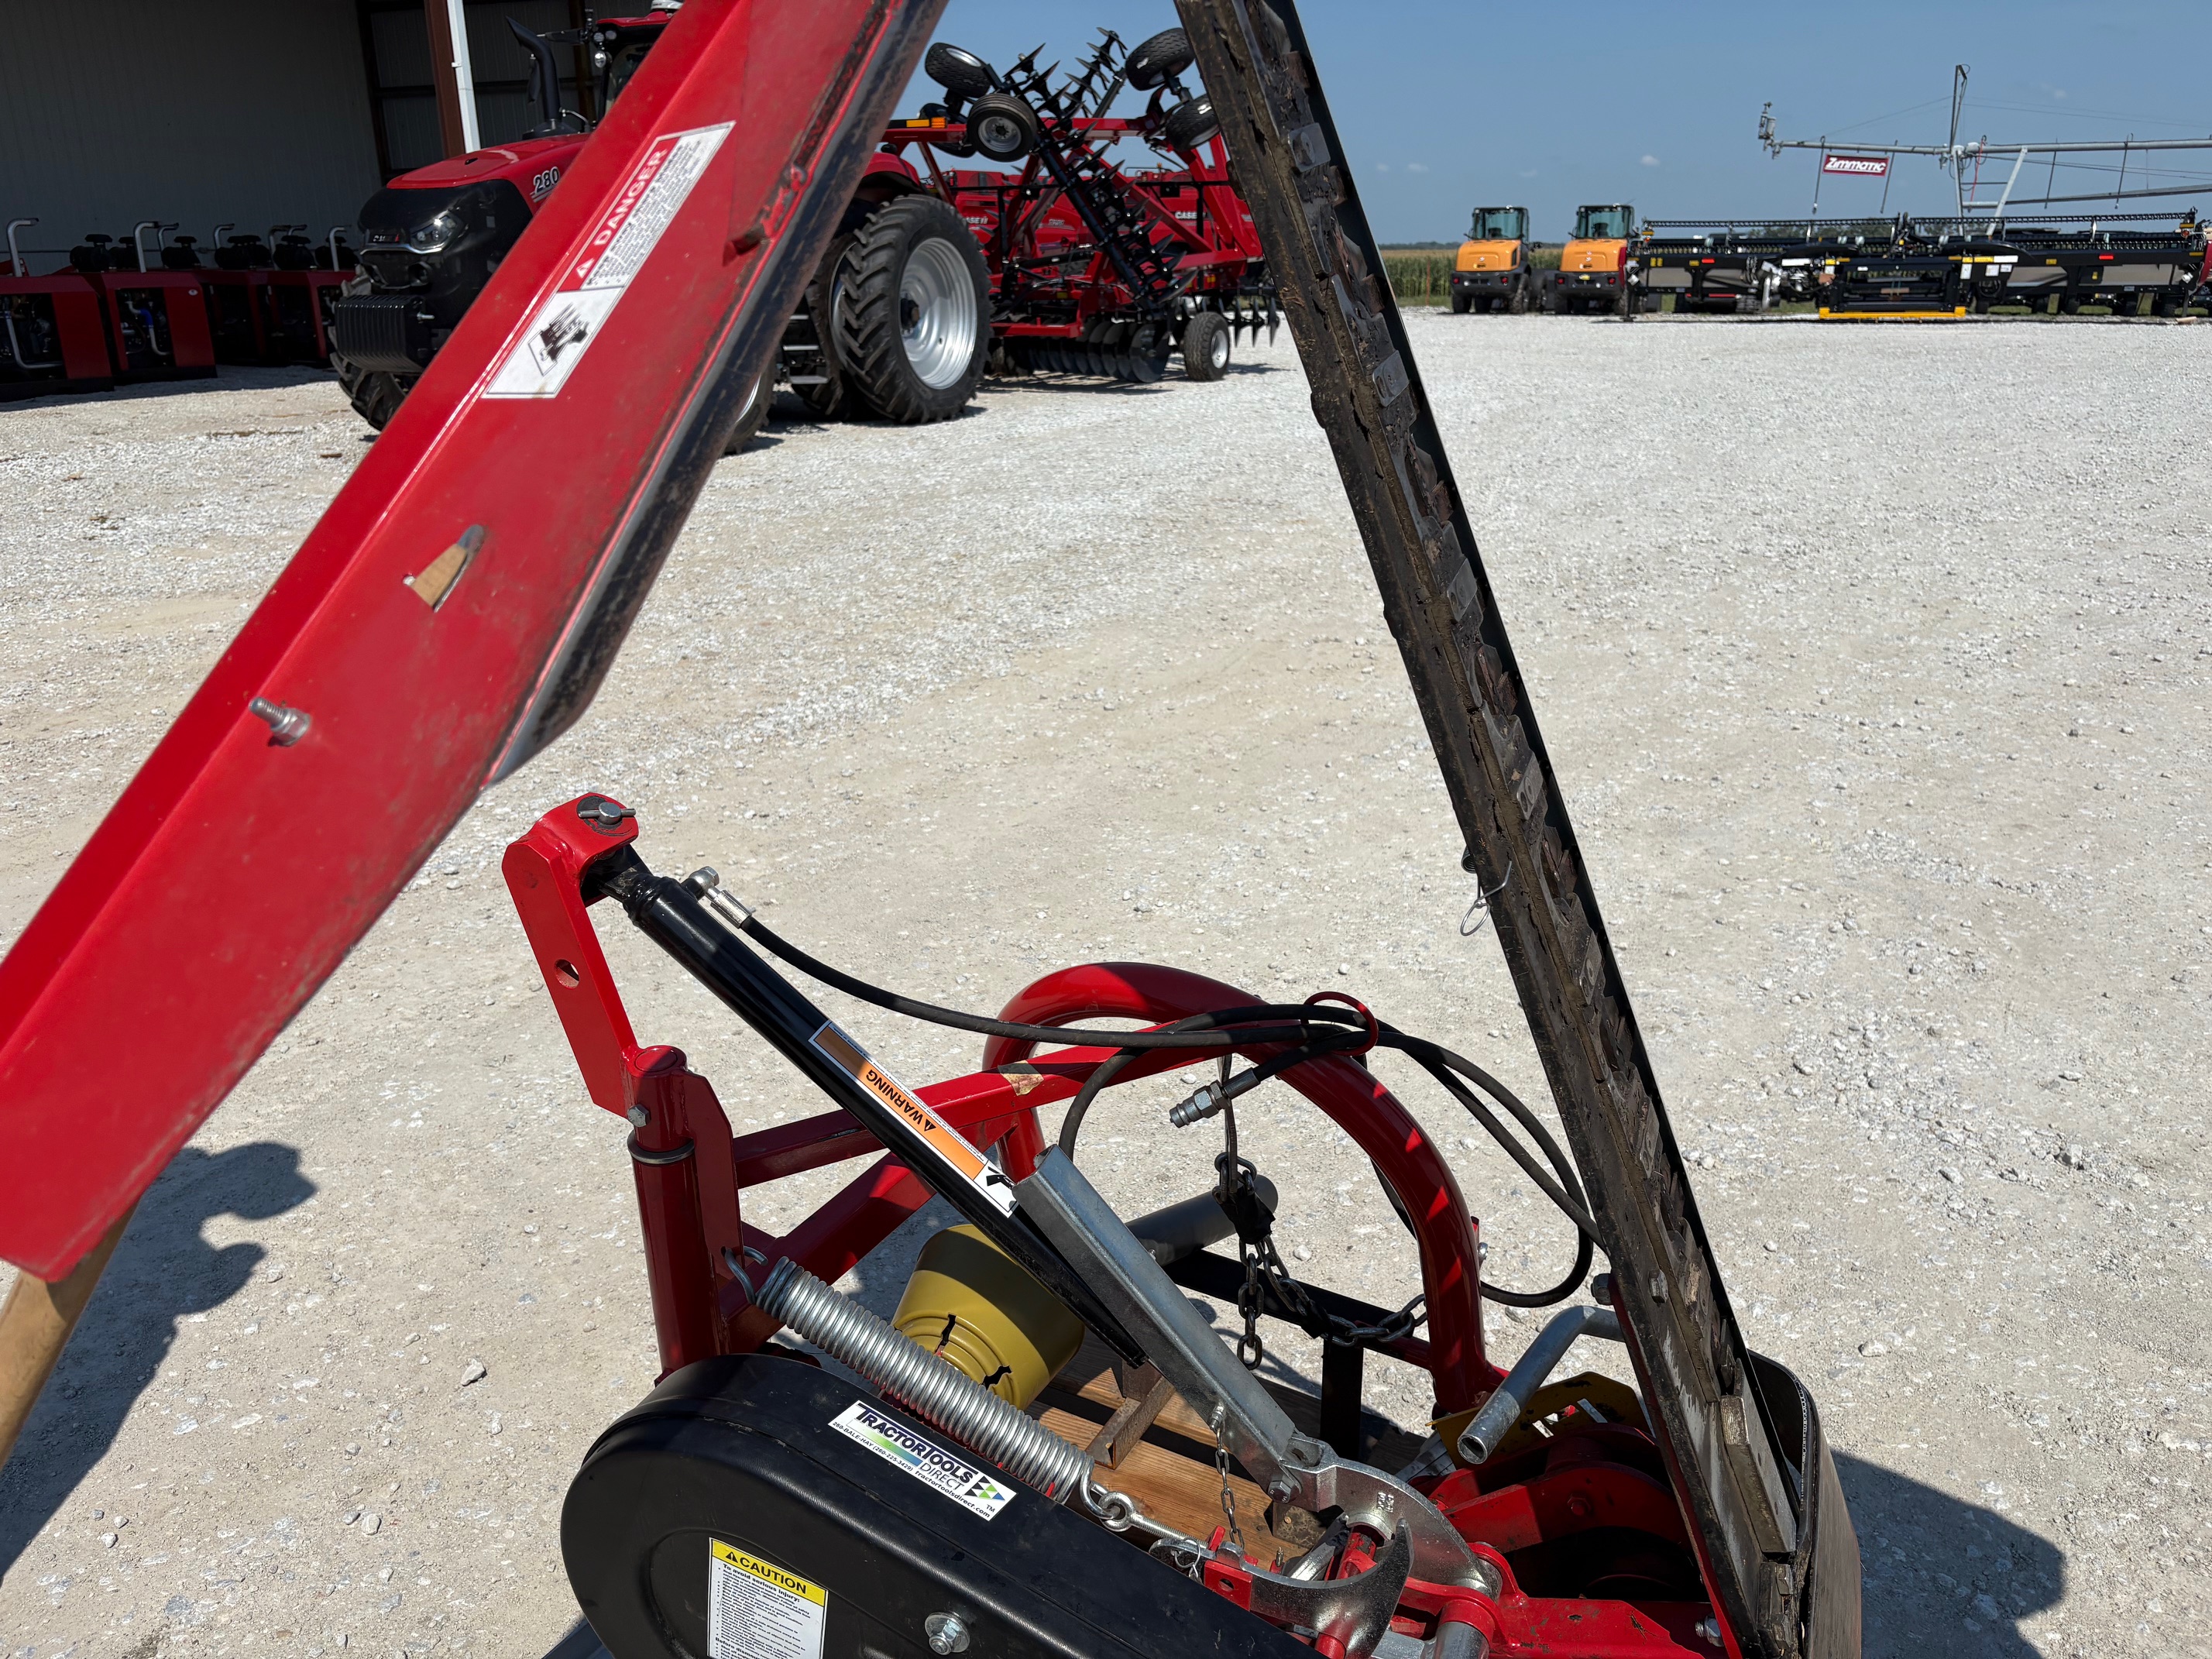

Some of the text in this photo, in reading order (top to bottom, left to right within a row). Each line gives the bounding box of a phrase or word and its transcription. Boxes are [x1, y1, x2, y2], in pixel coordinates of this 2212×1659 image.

[532, 167, 560, 194] 280
[1825, 156, 1887, 173] Zimmatic
[594, 149, 668, 246] DANGER
[866, 1068, 924, 1126] WARNING
[919, 1462, 964, 1492] DIRECT
[915, 1470, 990, 1518] tractortoolsdirect.com
[987, 1504, 996, 1513] TM
[733, 1569, 750, 1579] avoid
[752, 1578, 777, 1591] serious
[778, 1589, 800, 1602] injury:
[740, 1557, 807, 1594] CAUTION
